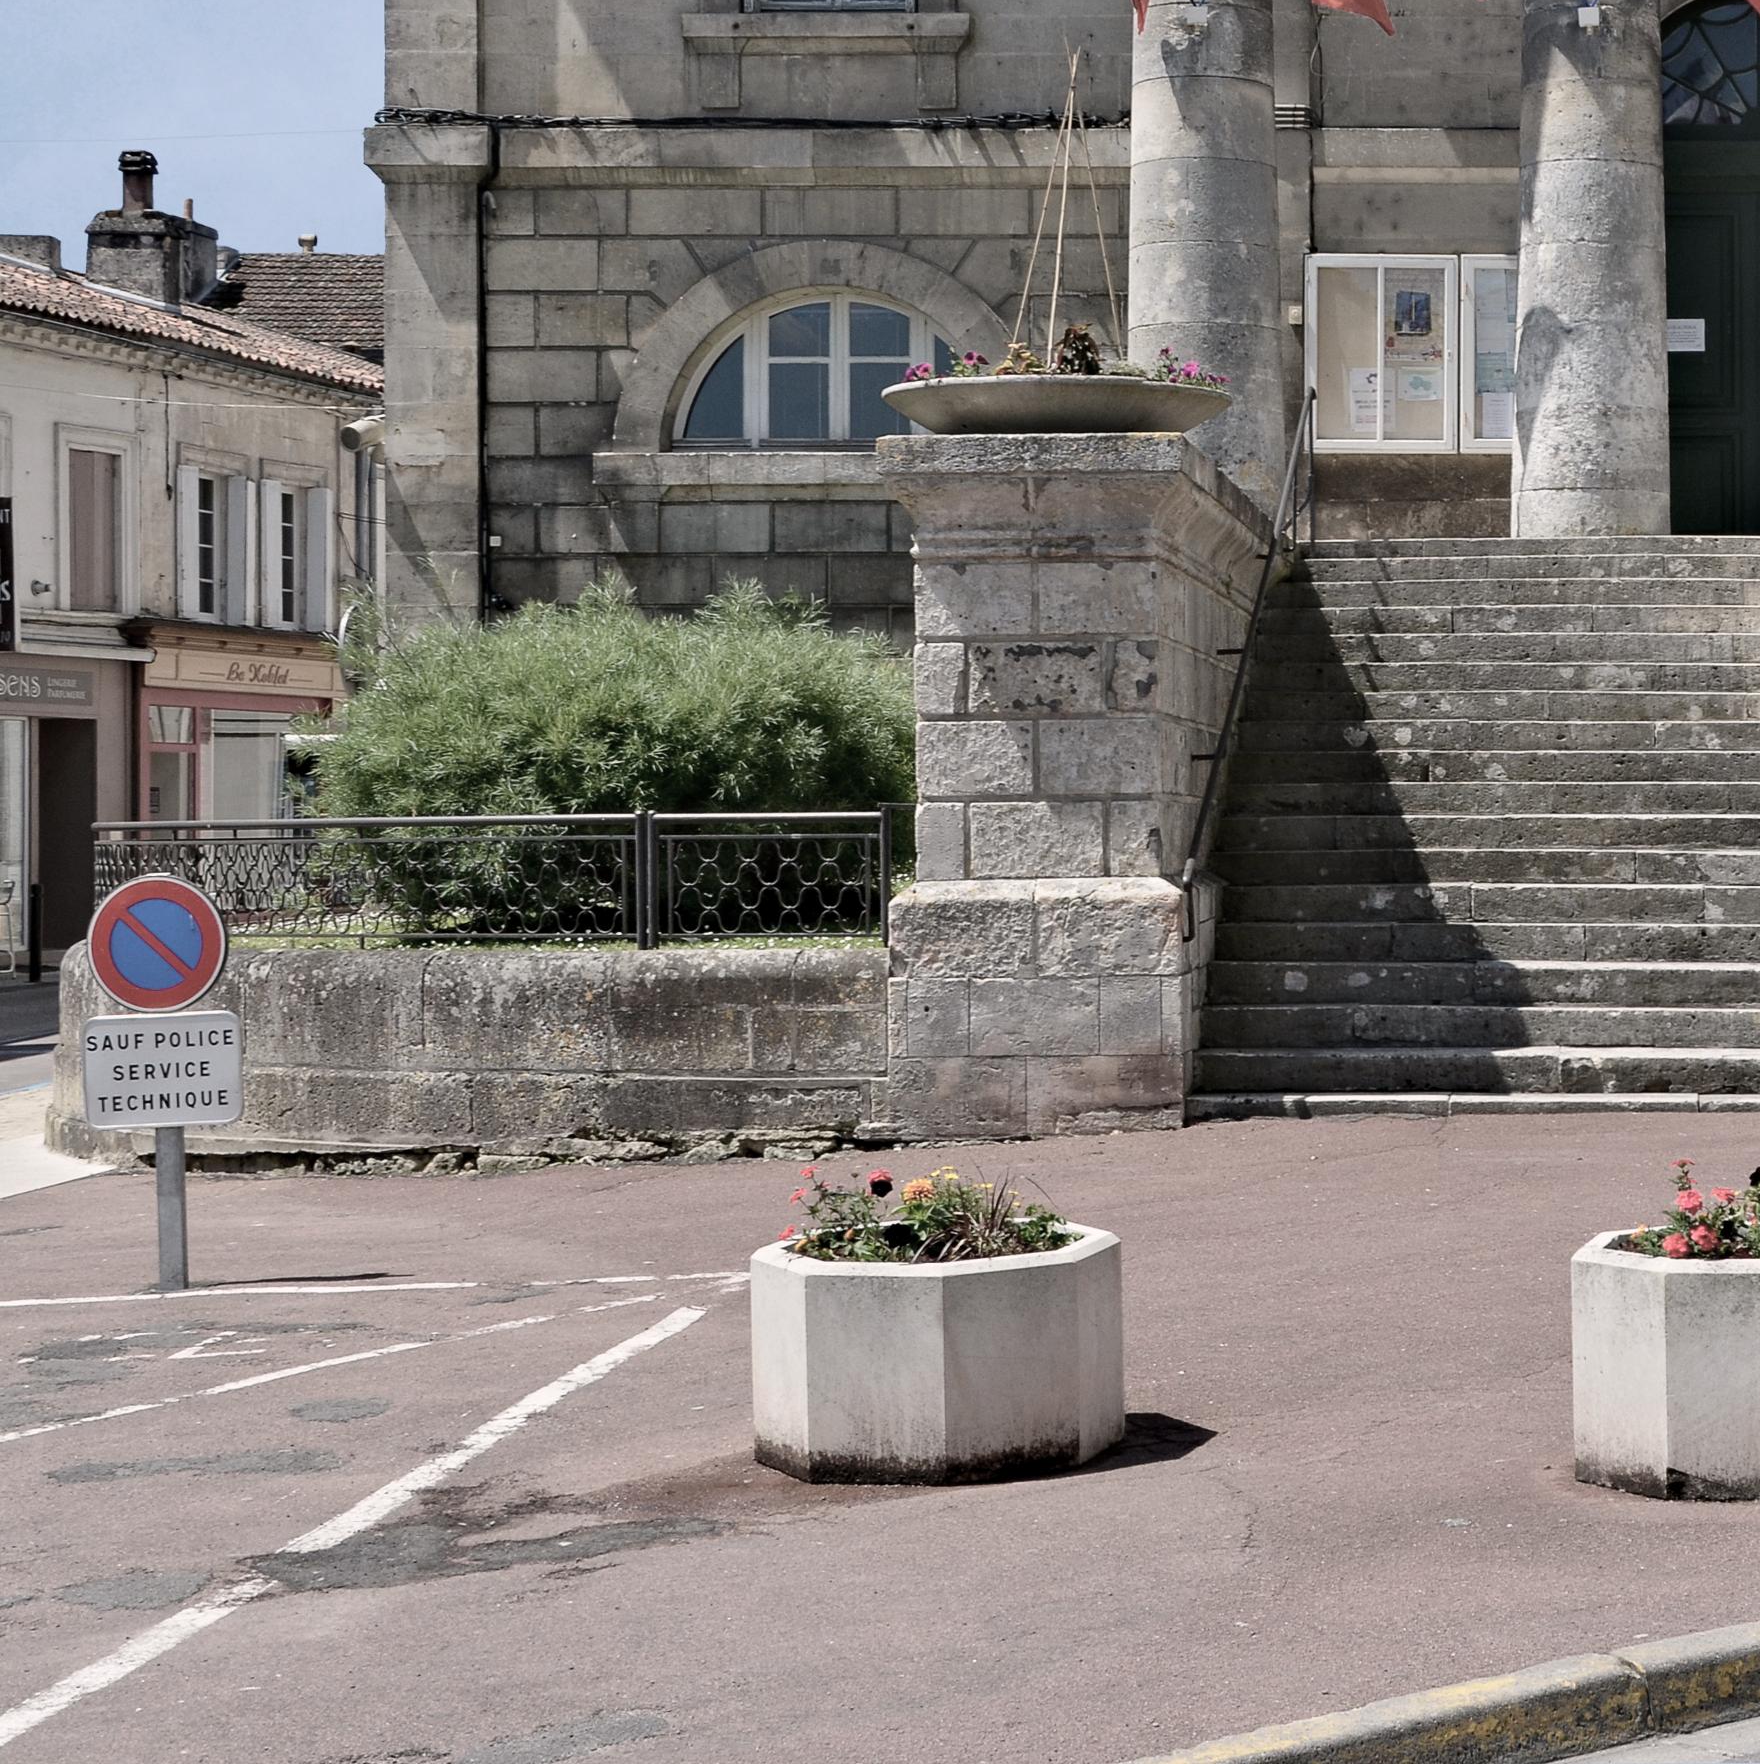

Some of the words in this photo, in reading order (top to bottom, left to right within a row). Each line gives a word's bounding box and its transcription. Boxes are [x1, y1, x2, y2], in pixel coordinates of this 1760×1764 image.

[86, 1033, 144, 1051] SAUF
[154, 1029, 235, 1049] POLICE
[112, 1061, 211, 1081] SERVICE
[98, 1090, 229, 1113] TECHNIQUE
